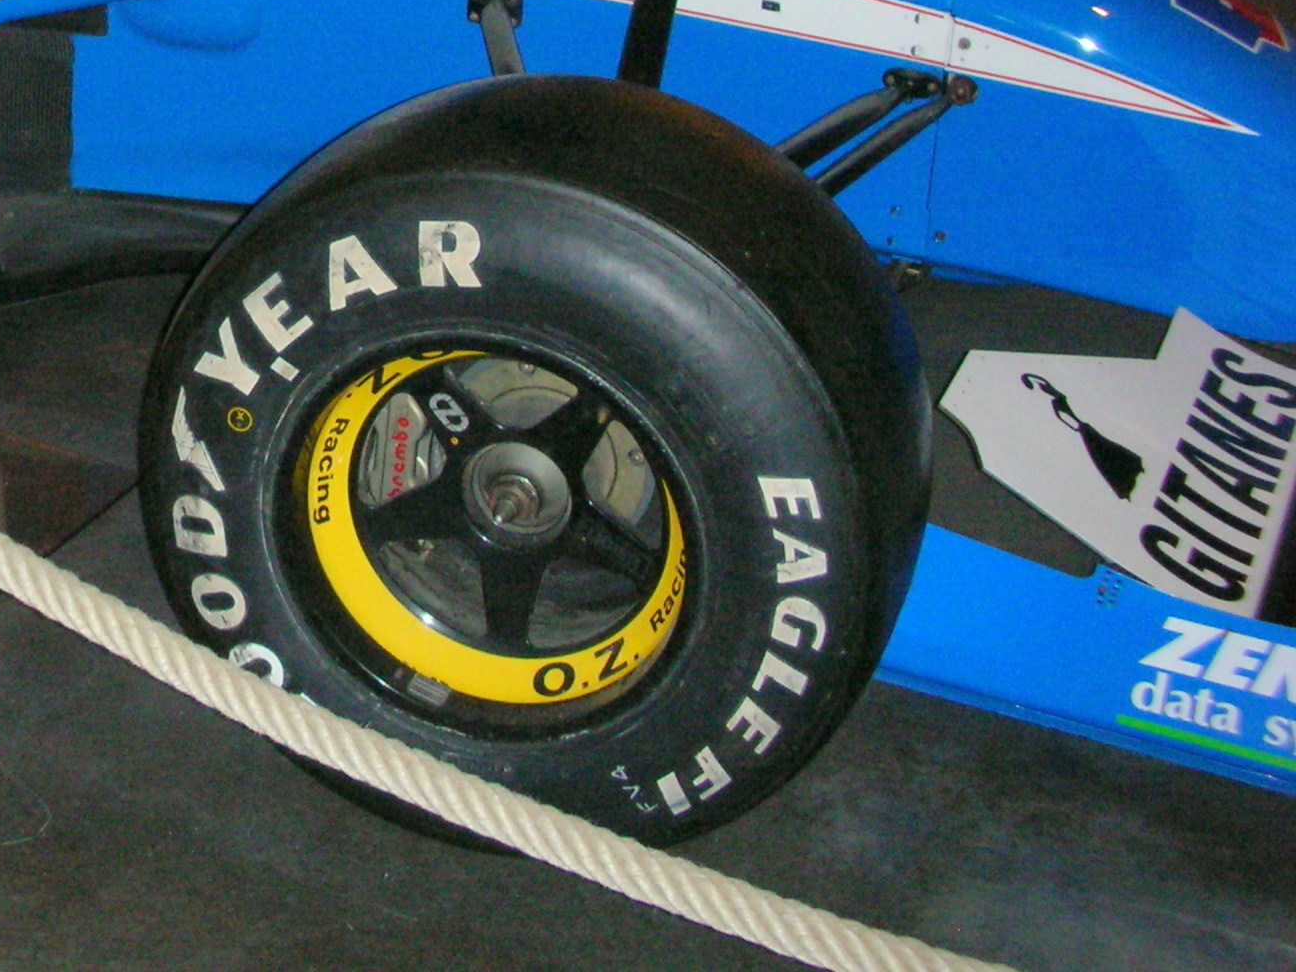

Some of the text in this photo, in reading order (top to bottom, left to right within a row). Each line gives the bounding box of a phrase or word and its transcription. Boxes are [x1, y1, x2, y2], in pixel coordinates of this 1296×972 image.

[313, 417, 351, 525] Racing
[1140, 348, 1296, 603] GITANES
[726, 476, 829, 755] EAGLE
[1130, 671, 1244, 735] data
